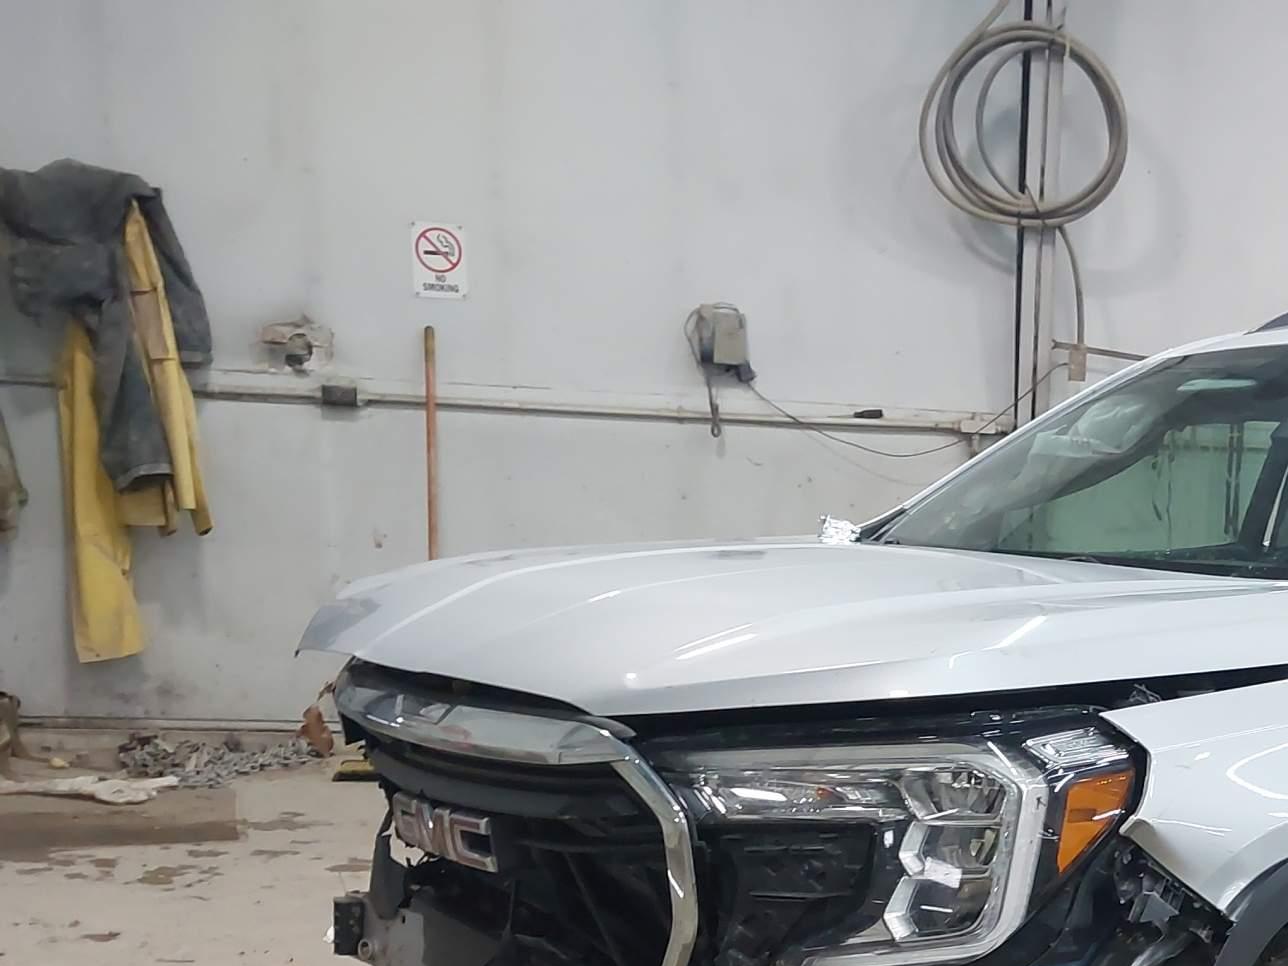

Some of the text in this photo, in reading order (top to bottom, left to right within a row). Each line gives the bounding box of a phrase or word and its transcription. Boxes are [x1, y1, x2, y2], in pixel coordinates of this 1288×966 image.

[435, 274, 446, 283] NO
[423, 283, 459, 292] SMOKING
[392, 791, 498, 873] GMC
